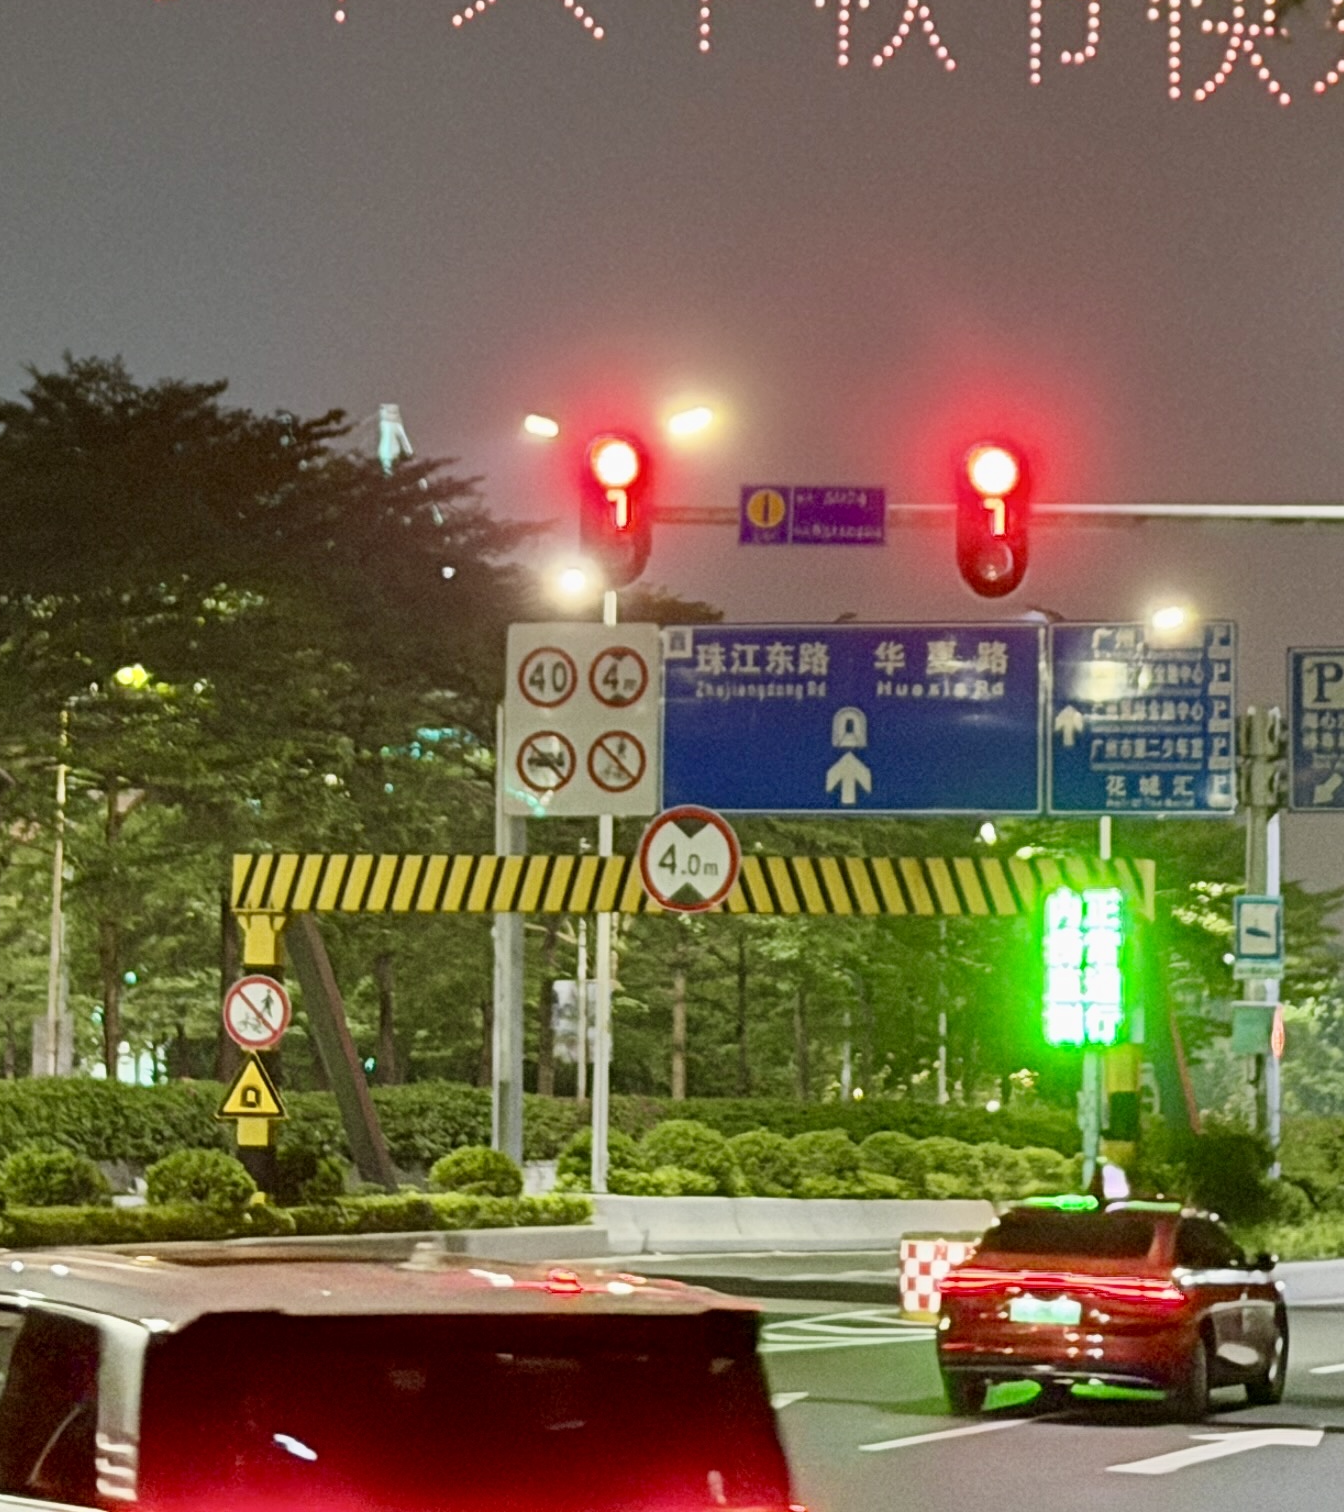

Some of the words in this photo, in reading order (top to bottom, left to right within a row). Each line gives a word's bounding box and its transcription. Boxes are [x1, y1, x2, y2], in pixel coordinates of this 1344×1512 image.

[695, 642, 829, 676] 珠江东路
[874, 641, 1008, 676] 华夏路
[529, 661, 568, 694] 40
[1307, 662, 1344, 703] P
[658, 842, 719, 877] 4.0m
